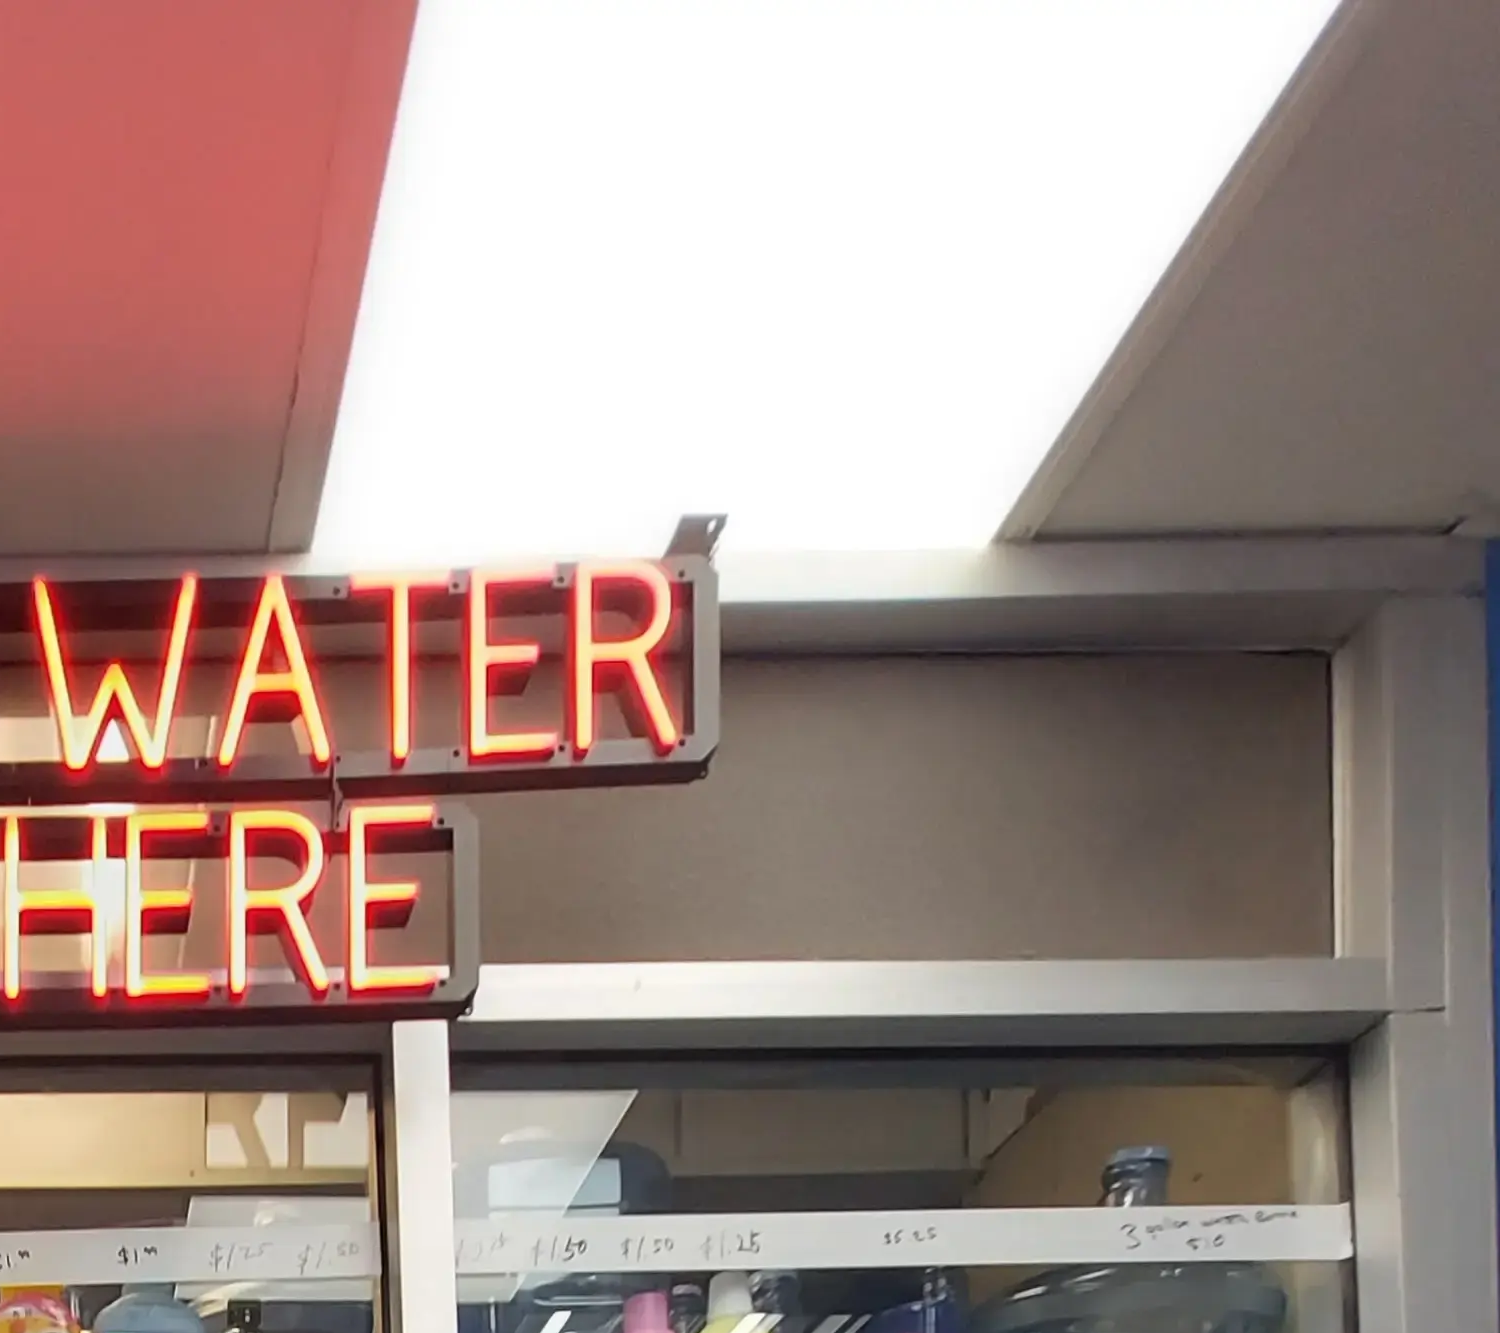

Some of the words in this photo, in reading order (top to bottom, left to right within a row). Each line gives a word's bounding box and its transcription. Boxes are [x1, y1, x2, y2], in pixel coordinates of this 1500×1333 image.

[31, 560, 681, 772] WATER
[0, 803, 440, 998] HERE
[1119, 1223, 1142, 1250] 3
